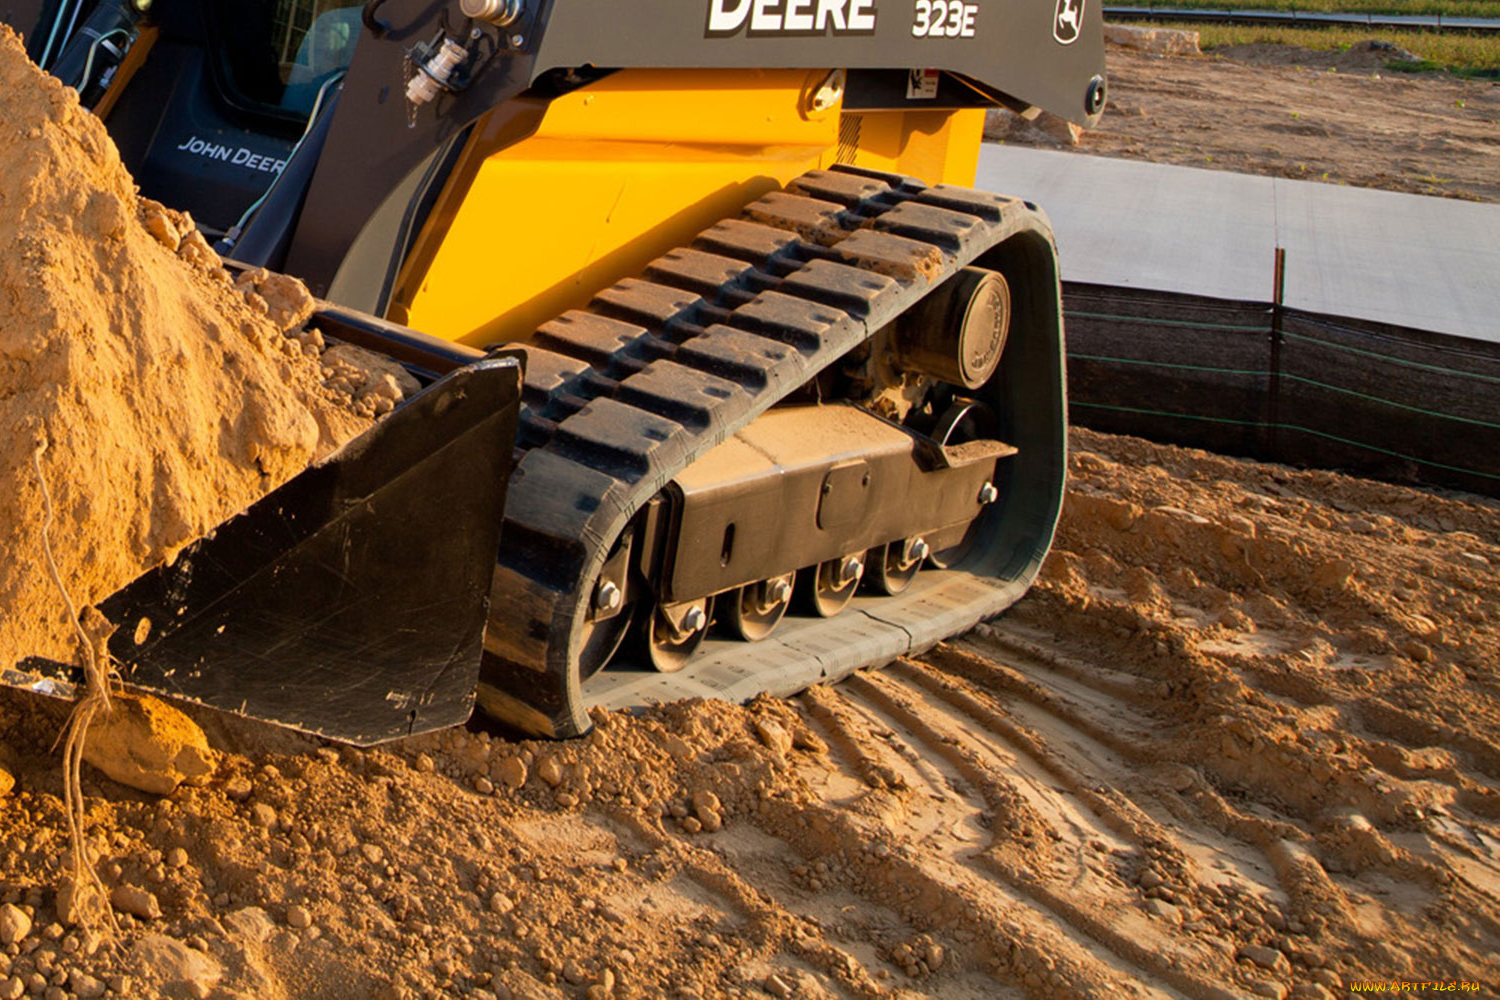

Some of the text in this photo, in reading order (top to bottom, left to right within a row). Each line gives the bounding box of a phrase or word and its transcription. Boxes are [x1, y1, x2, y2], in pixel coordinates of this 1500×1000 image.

[912, 0, 977, 38] 323E
[177, 136, 287, 174] JOHN DEER
